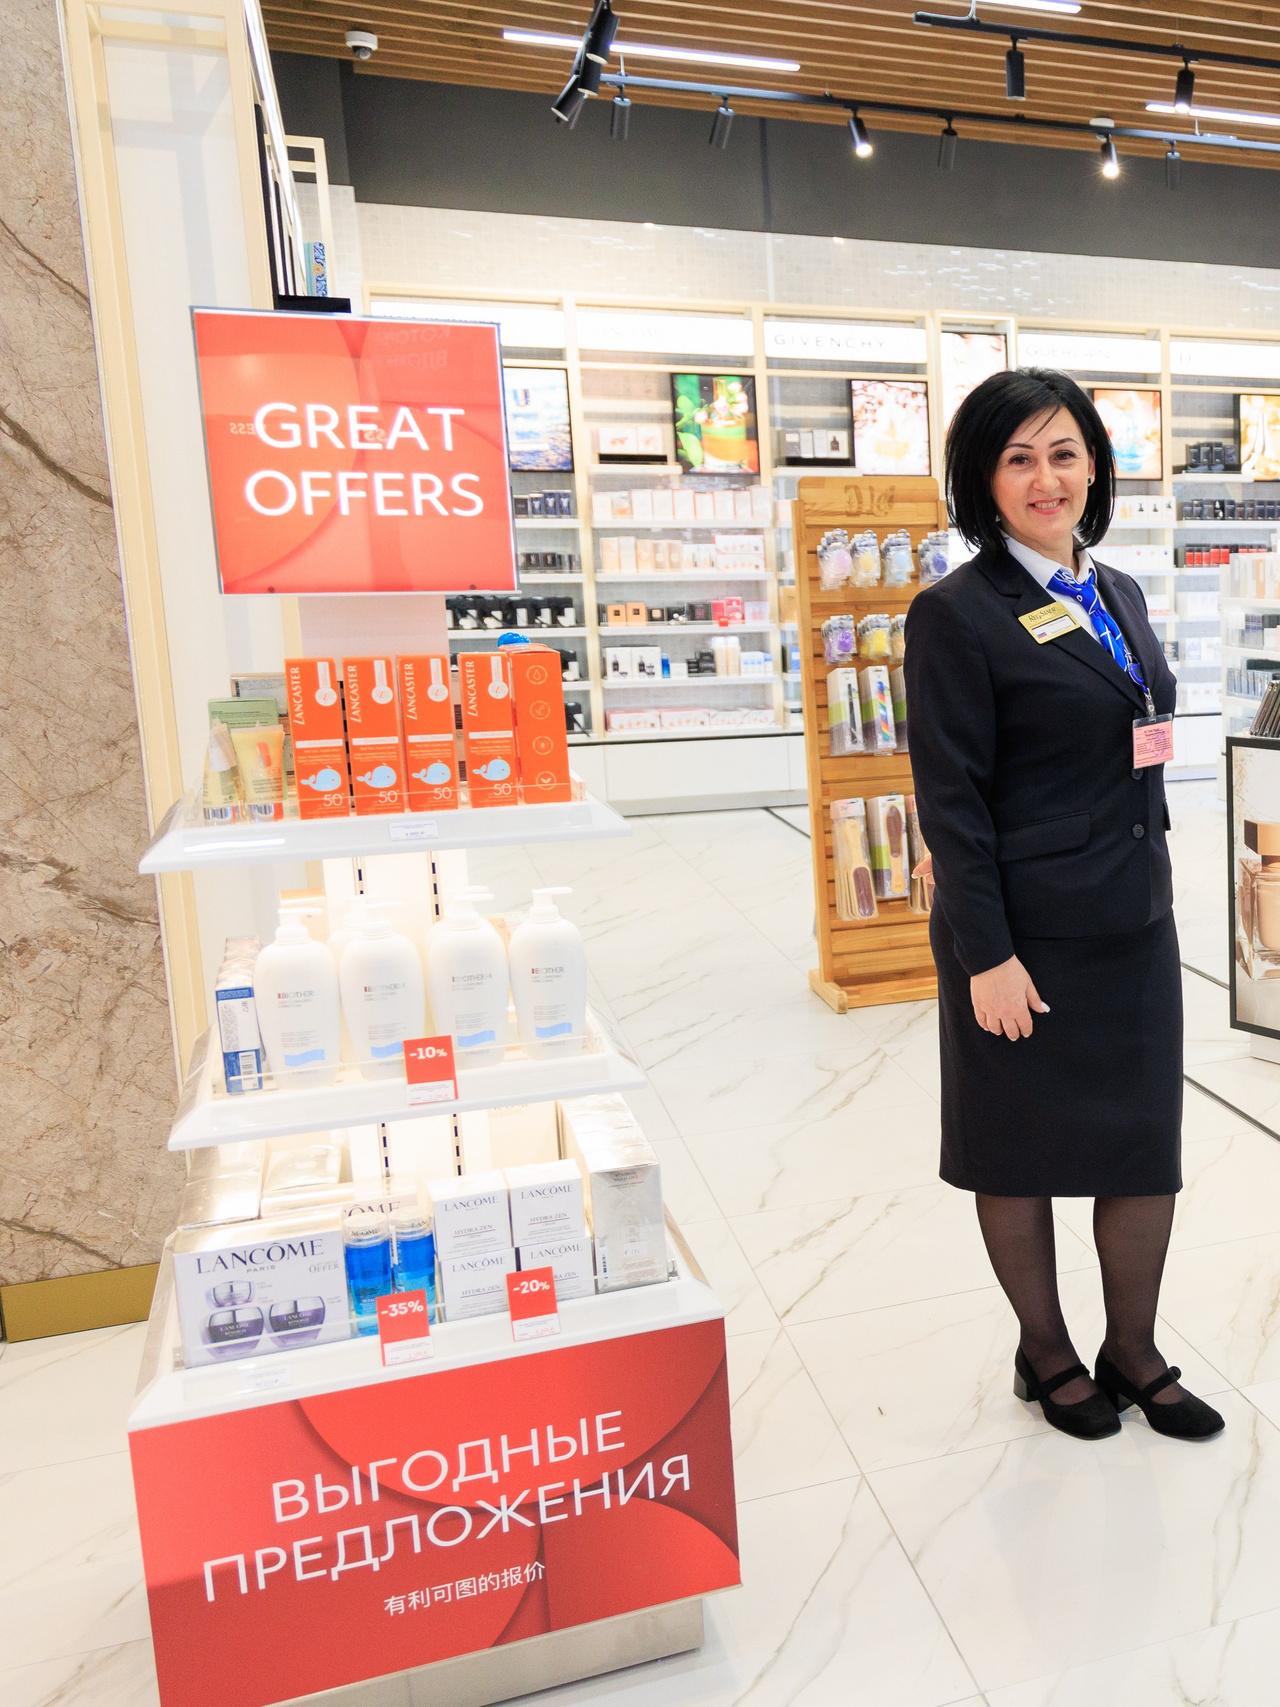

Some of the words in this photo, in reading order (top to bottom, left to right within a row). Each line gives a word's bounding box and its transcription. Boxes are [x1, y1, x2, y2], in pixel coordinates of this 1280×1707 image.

[773, 333, 887, 351] GIVENCHY
[1025, 343, 1110, 361] GUERLAIN
[253, 402, 465, 453] GREAT
[244, 469, 485, 518] OFFERS
[293, 667, 306, 726] LANCASTER
[349, 665, 362, 723] LANCASTER
[405, 663, 418, 721] LANCASTER
[466, 660, 479, 718] LANCASTER
[409, 1046, 448, 1060] -10%
[520, 1184, 574, 1200] LANCÔME
[444, 1194, 499, 1212] LANCÔME
[529, 1213, 554, 1223] HYDRA
[454, 1226, 478, 1236] HYDRA
[479, 1223, 493, 1232] ZEN
[196, 1237, 324, 1274] LANCÔME
[530, 1243, 583, 1260] LANCÔME
[246, 1265, 276, 1273] PARIS
[308, 1262, 340, 1274] OFFER
[452, 1255, 507, 1273] LANCÔME
[564, 1270, 577, 1279] ZEN
[462, 1286, 486, 1296] HYDRA
[486, 1284, 500, 1292] ZEN
[512, 1279, 550, 1294] -20%
[283, 1311, 312, 1321] LANCÔME
[380, 1299, 425, 1319] -35%
[271, 1409, 626, 1524] ВЫГОДНЫЕ
[202, 1453, 692, 1603] ПРЕДЛОЖЕНИЯ
[383, 1561, 546, 1617] 有利可图的报价
